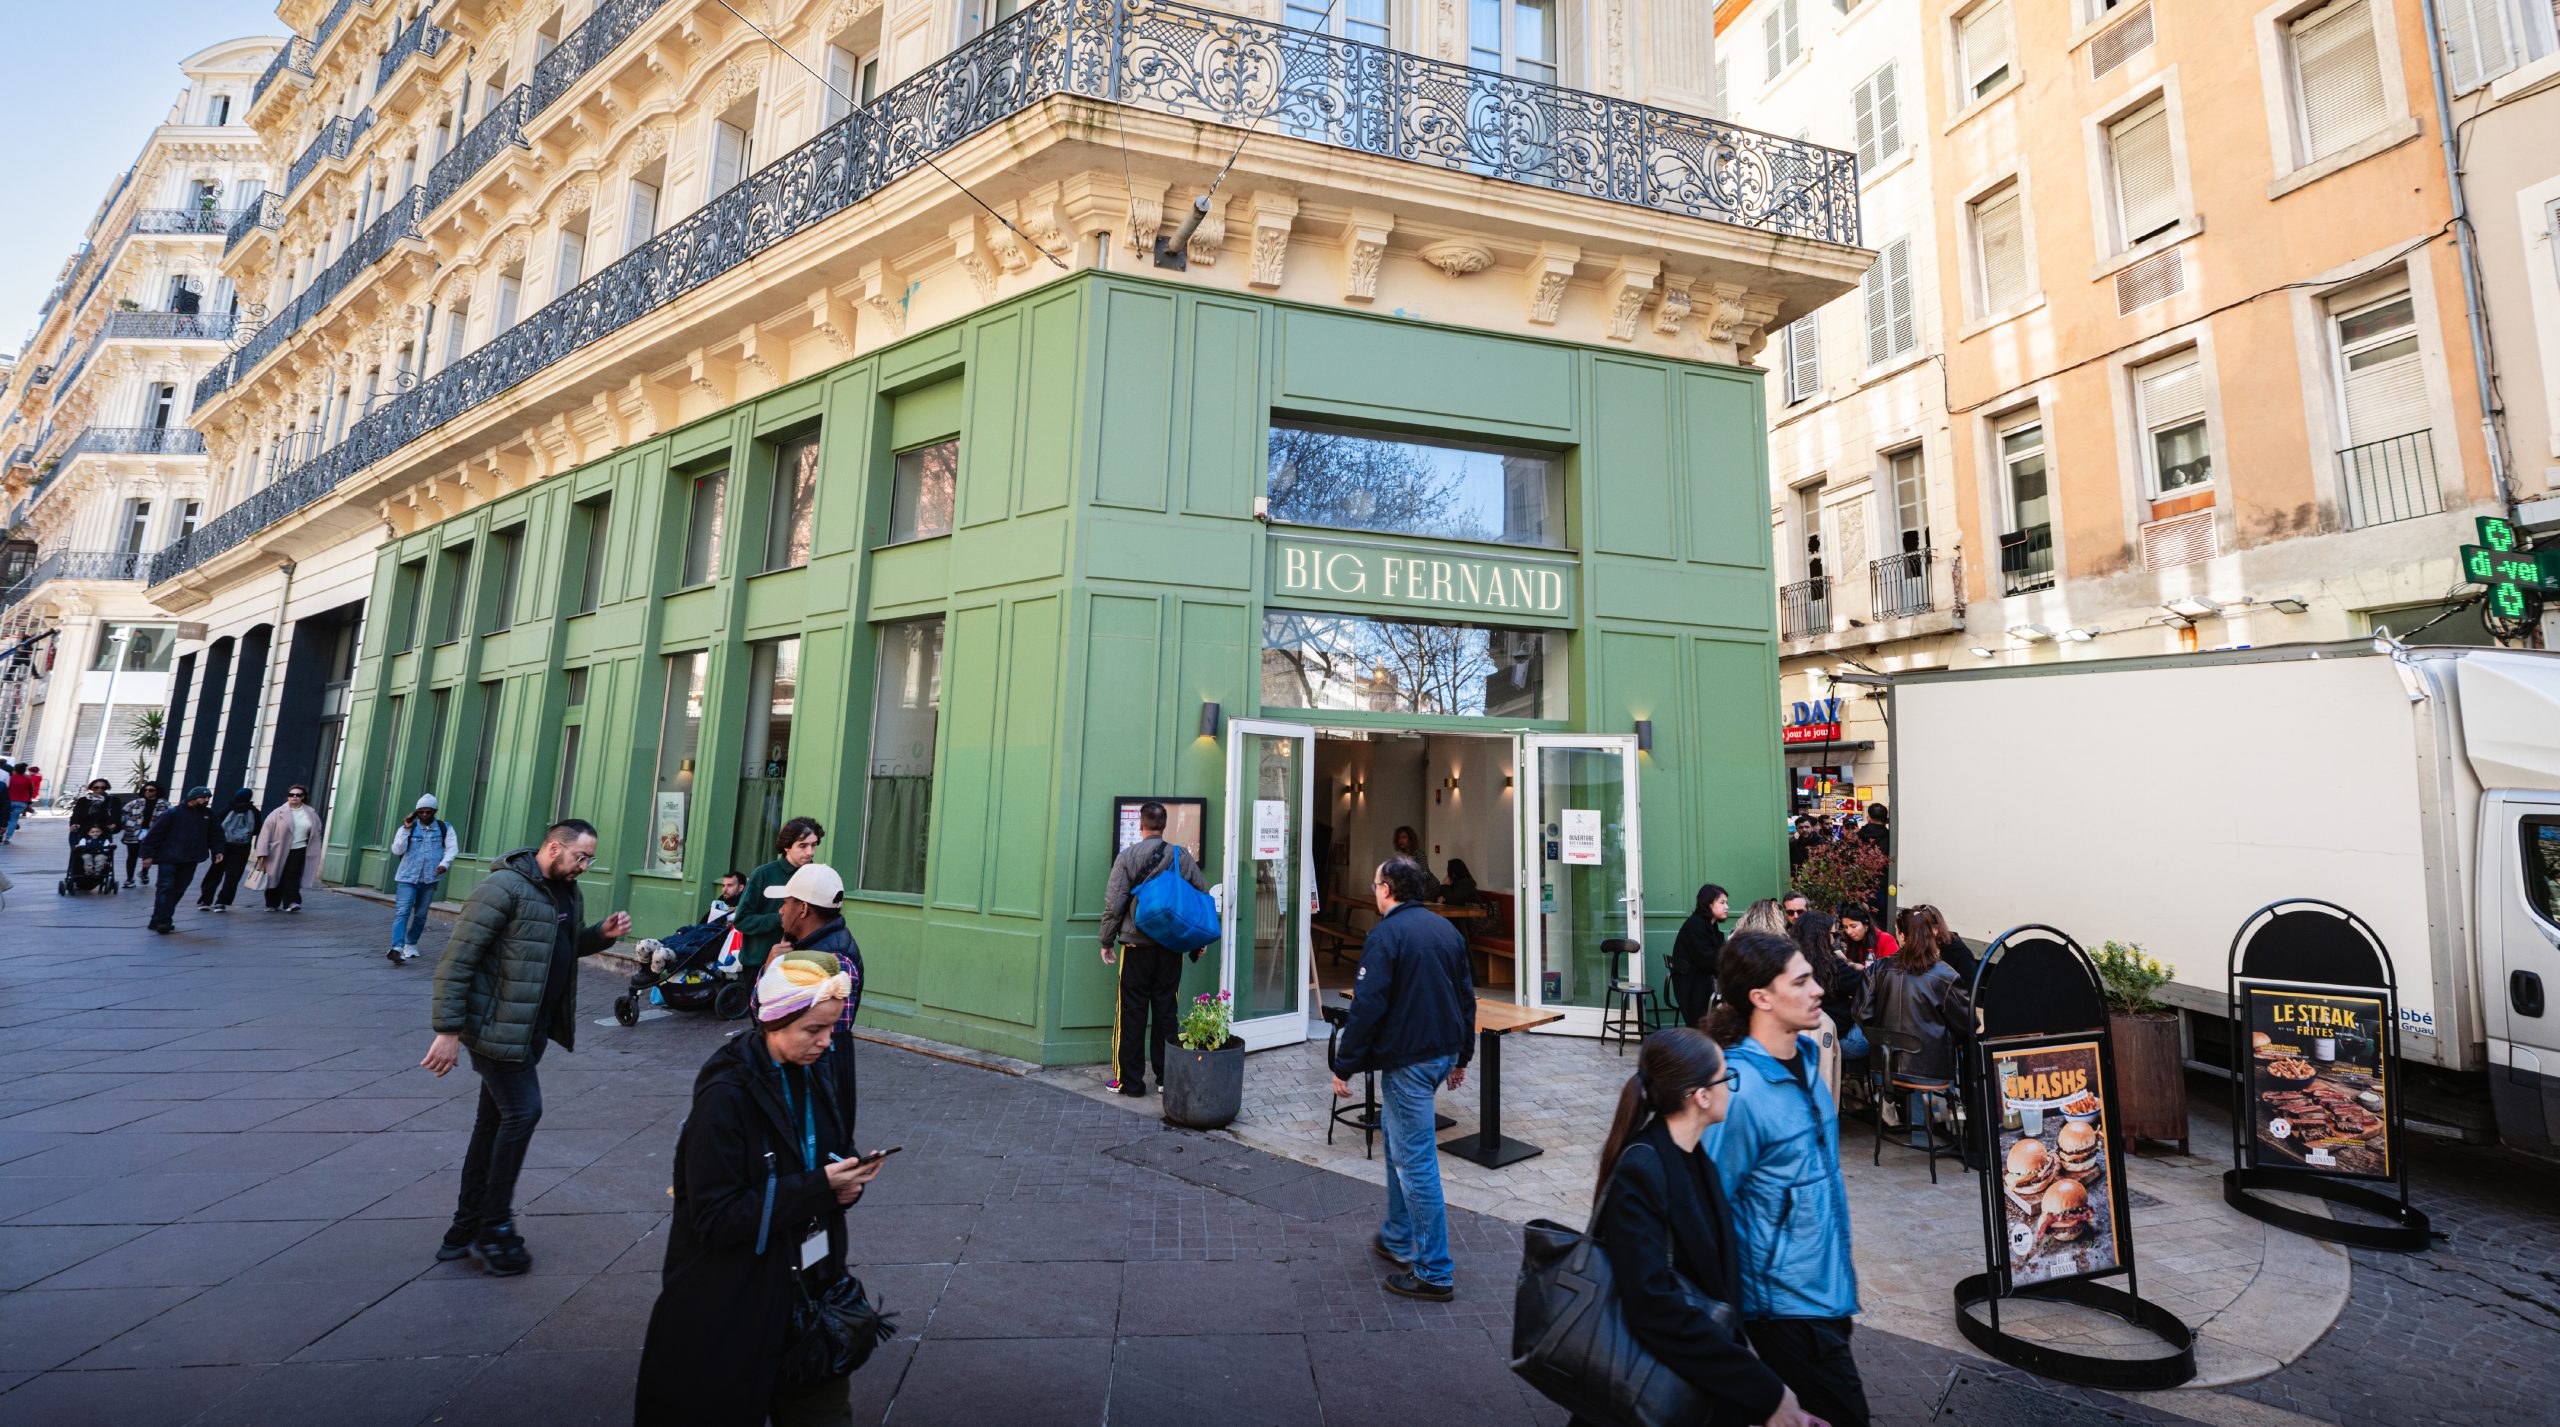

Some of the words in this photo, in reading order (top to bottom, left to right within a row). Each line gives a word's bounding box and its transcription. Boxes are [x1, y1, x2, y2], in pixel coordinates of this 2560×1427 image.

[1284, 548, 1366, 594] BIG
[1382, 557, 1562, 611] FERNAND
[1792, 698, 1842, 726] DAY
[1803, 728, 1812, 738] le
[2273, 1004, 2295, 1023] LE
[2298, 1004, 2357, 1030] STEAK
[2400, 1007, 2433, 1025] bbé
[2296, 1025, 2335, 1038] FRITES
[2401, 1022, 2435, 1035] Gruau
[2005, 1068, 2088, 1099] SMASHS
